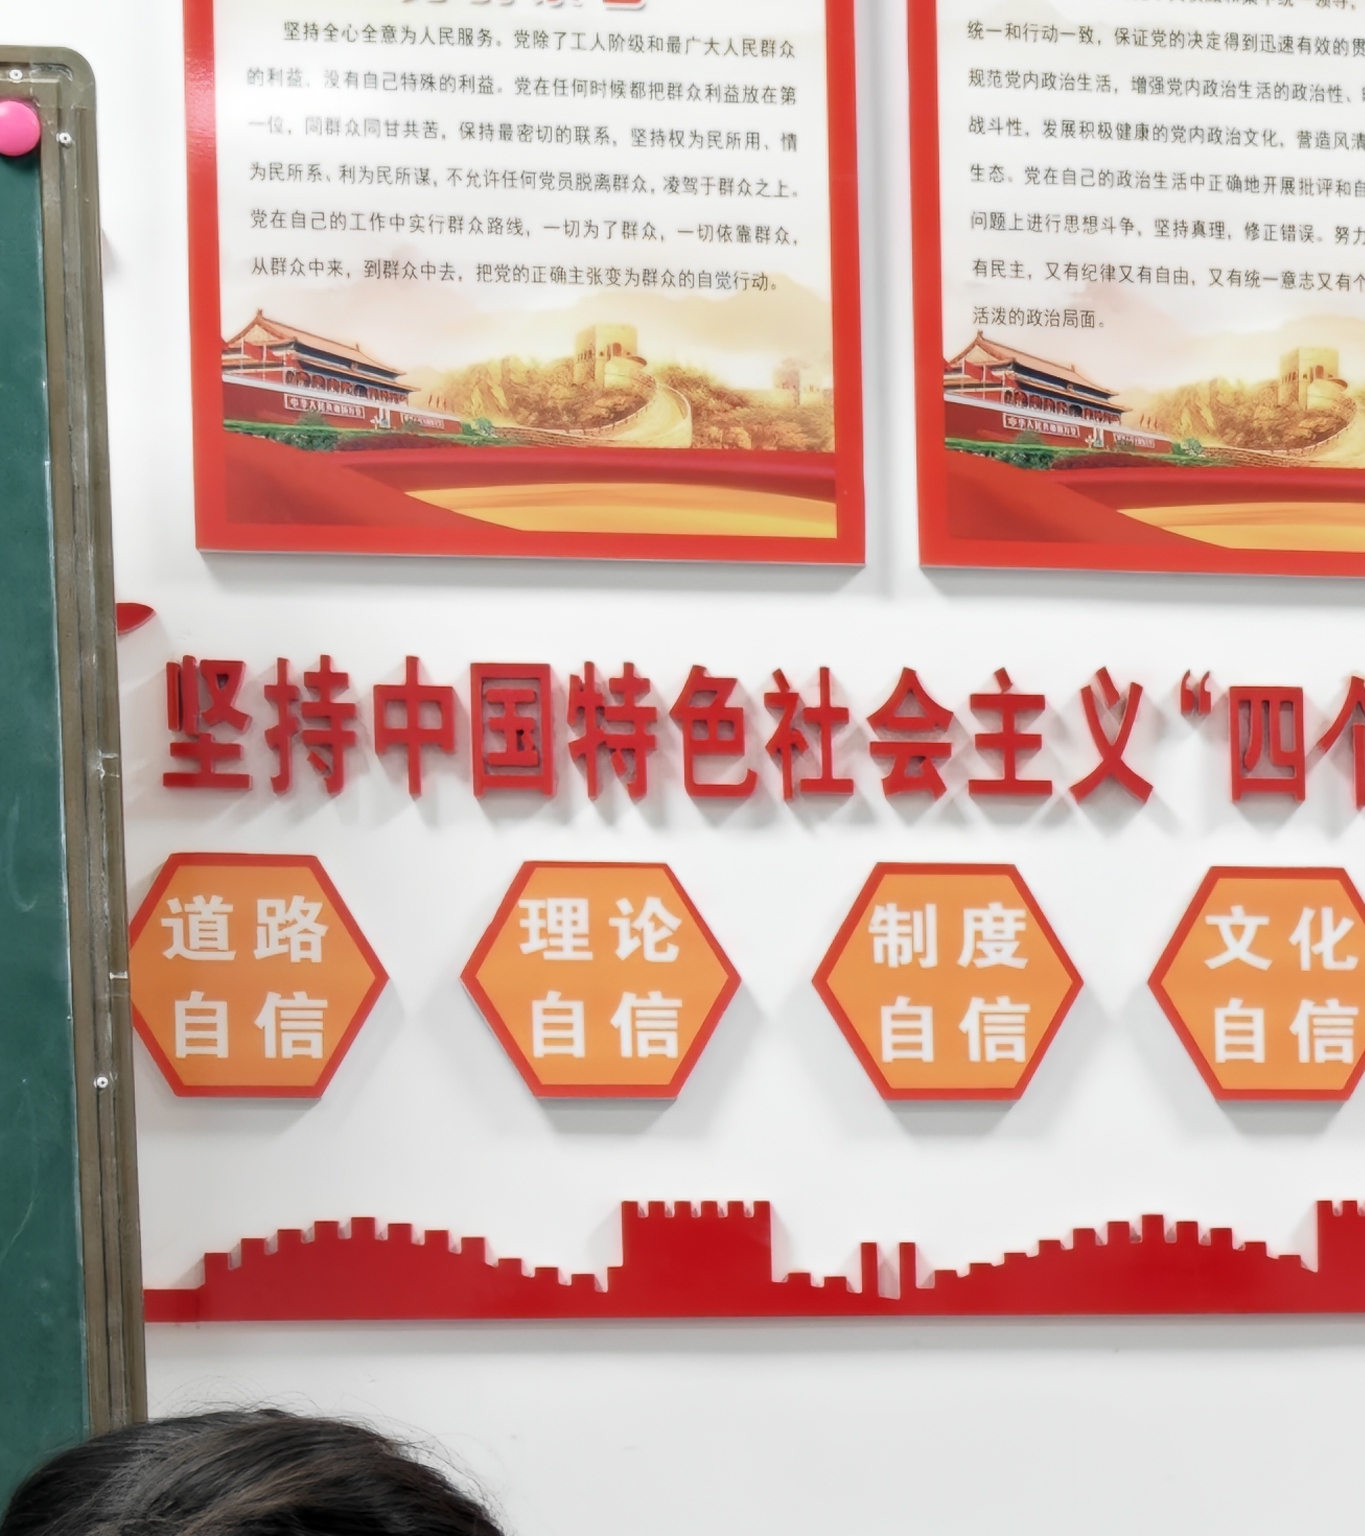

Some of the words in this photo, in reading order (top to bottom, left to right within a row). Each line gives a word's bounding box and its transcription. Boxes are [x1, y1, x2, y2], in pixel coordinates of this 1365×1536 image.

[160, 894, 331, 966] 道路
[519, 896, 683, 967] 理论
[866, 901, 1030, 971] 制度
[1202, 903, 1358, 971] 文化
[169, 991, 331, 1061] 自信
[526, 991, 683, 1061] 自信
[877, 994, 1031, 1065] 自信
[1209, 995, 1361, 1065] 自信
